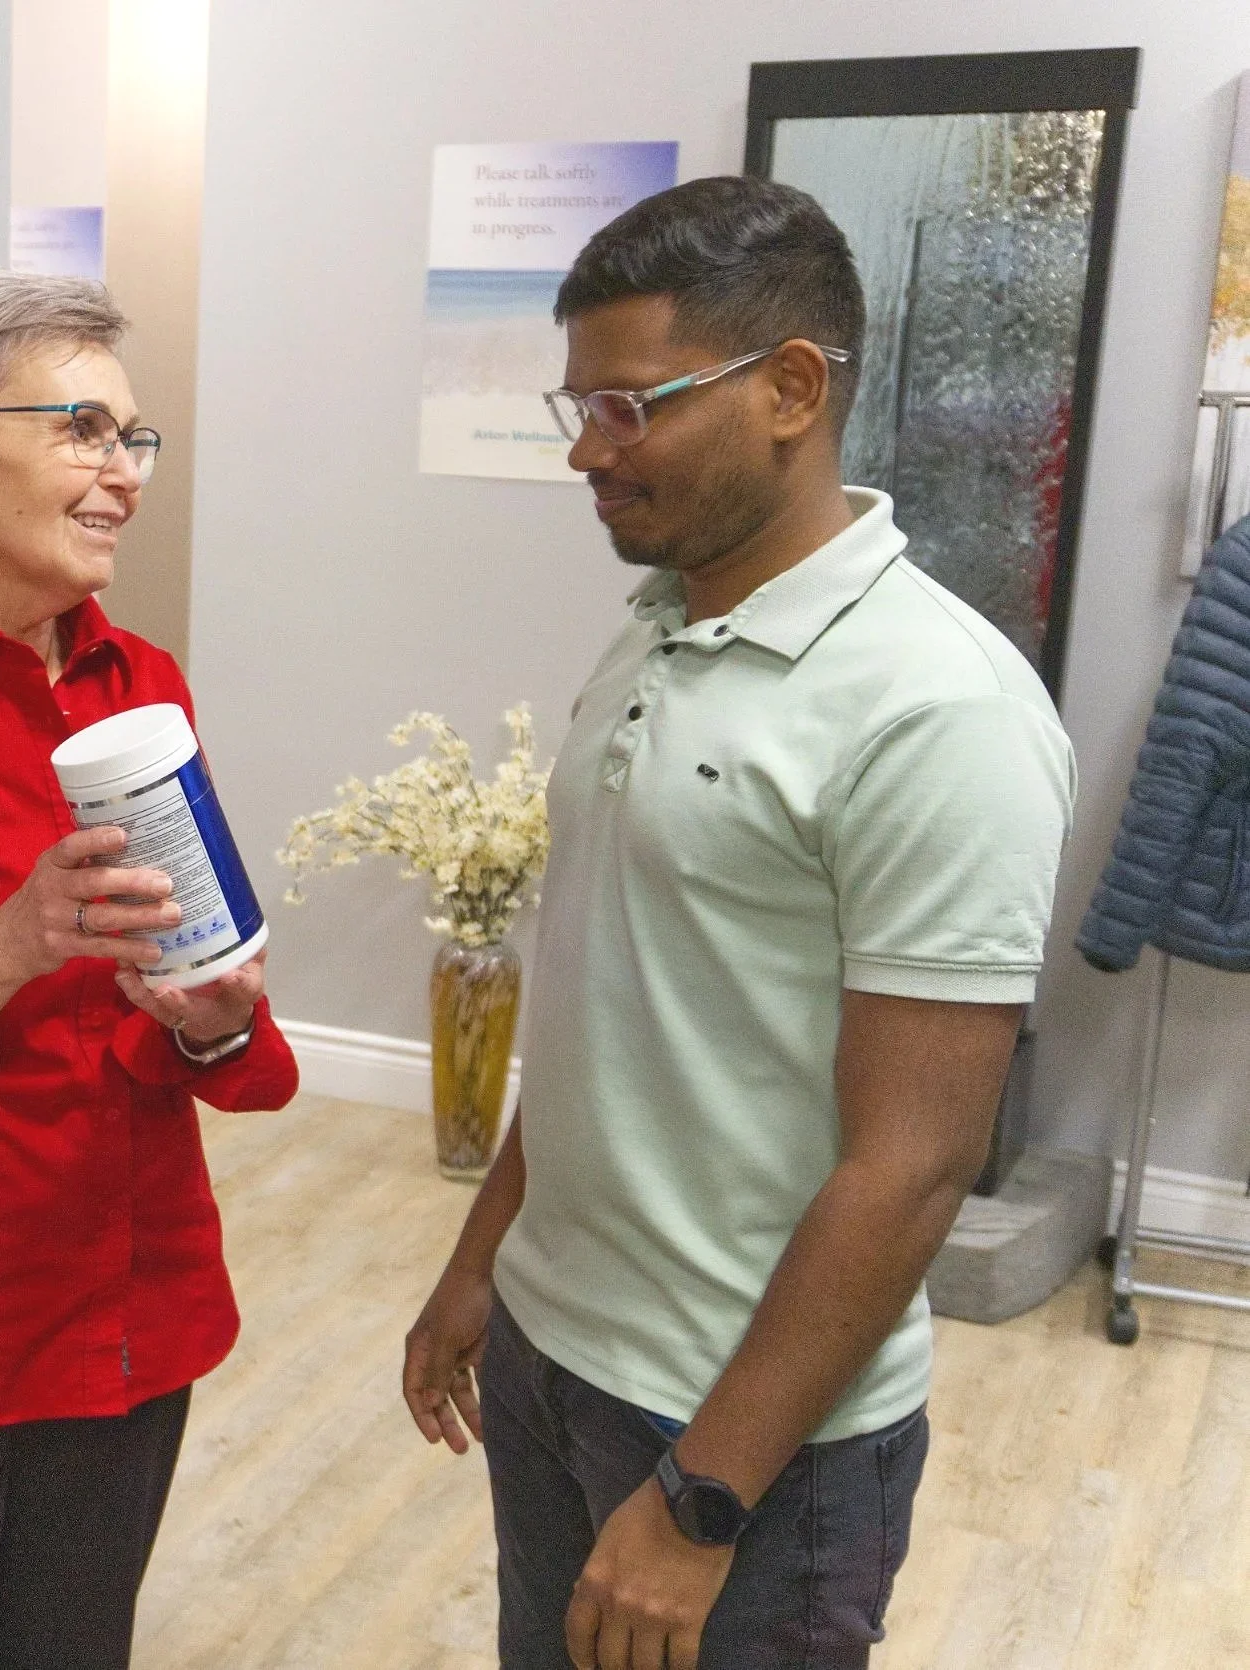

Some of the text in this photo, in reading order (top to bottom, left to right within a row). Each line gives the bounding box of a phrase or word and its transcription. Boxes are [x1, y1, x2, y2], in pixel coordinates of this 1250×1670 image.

[475, 163, 598, 185] Please talk softly
[475, 192, 513, 208] while
[518, 195, 600, 208] treatments
[473, 224, 487, 234] in
